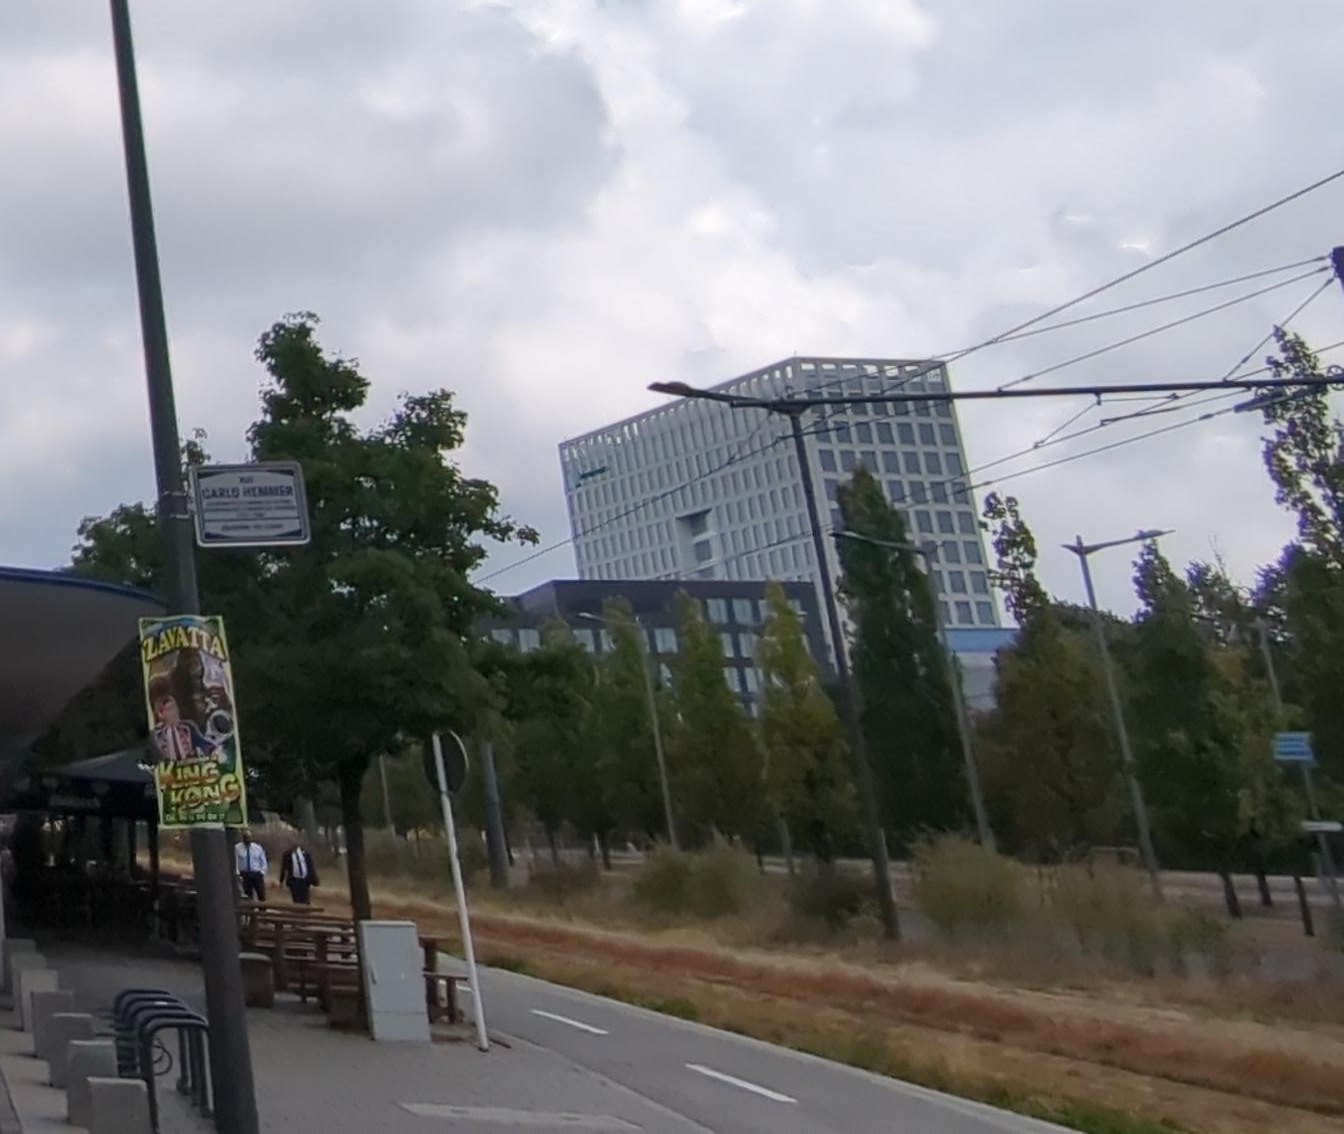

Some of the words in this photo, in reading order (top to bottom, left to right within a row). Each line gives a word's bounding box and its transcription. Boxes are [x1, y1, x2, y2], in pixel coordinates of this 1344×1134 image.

[202, 487, 240, 499] CARLO
[143, 626, 227, 660] ZAVATTA
[159, 761, 220, 788] KING
[170, 773, 240, 806] KONG
